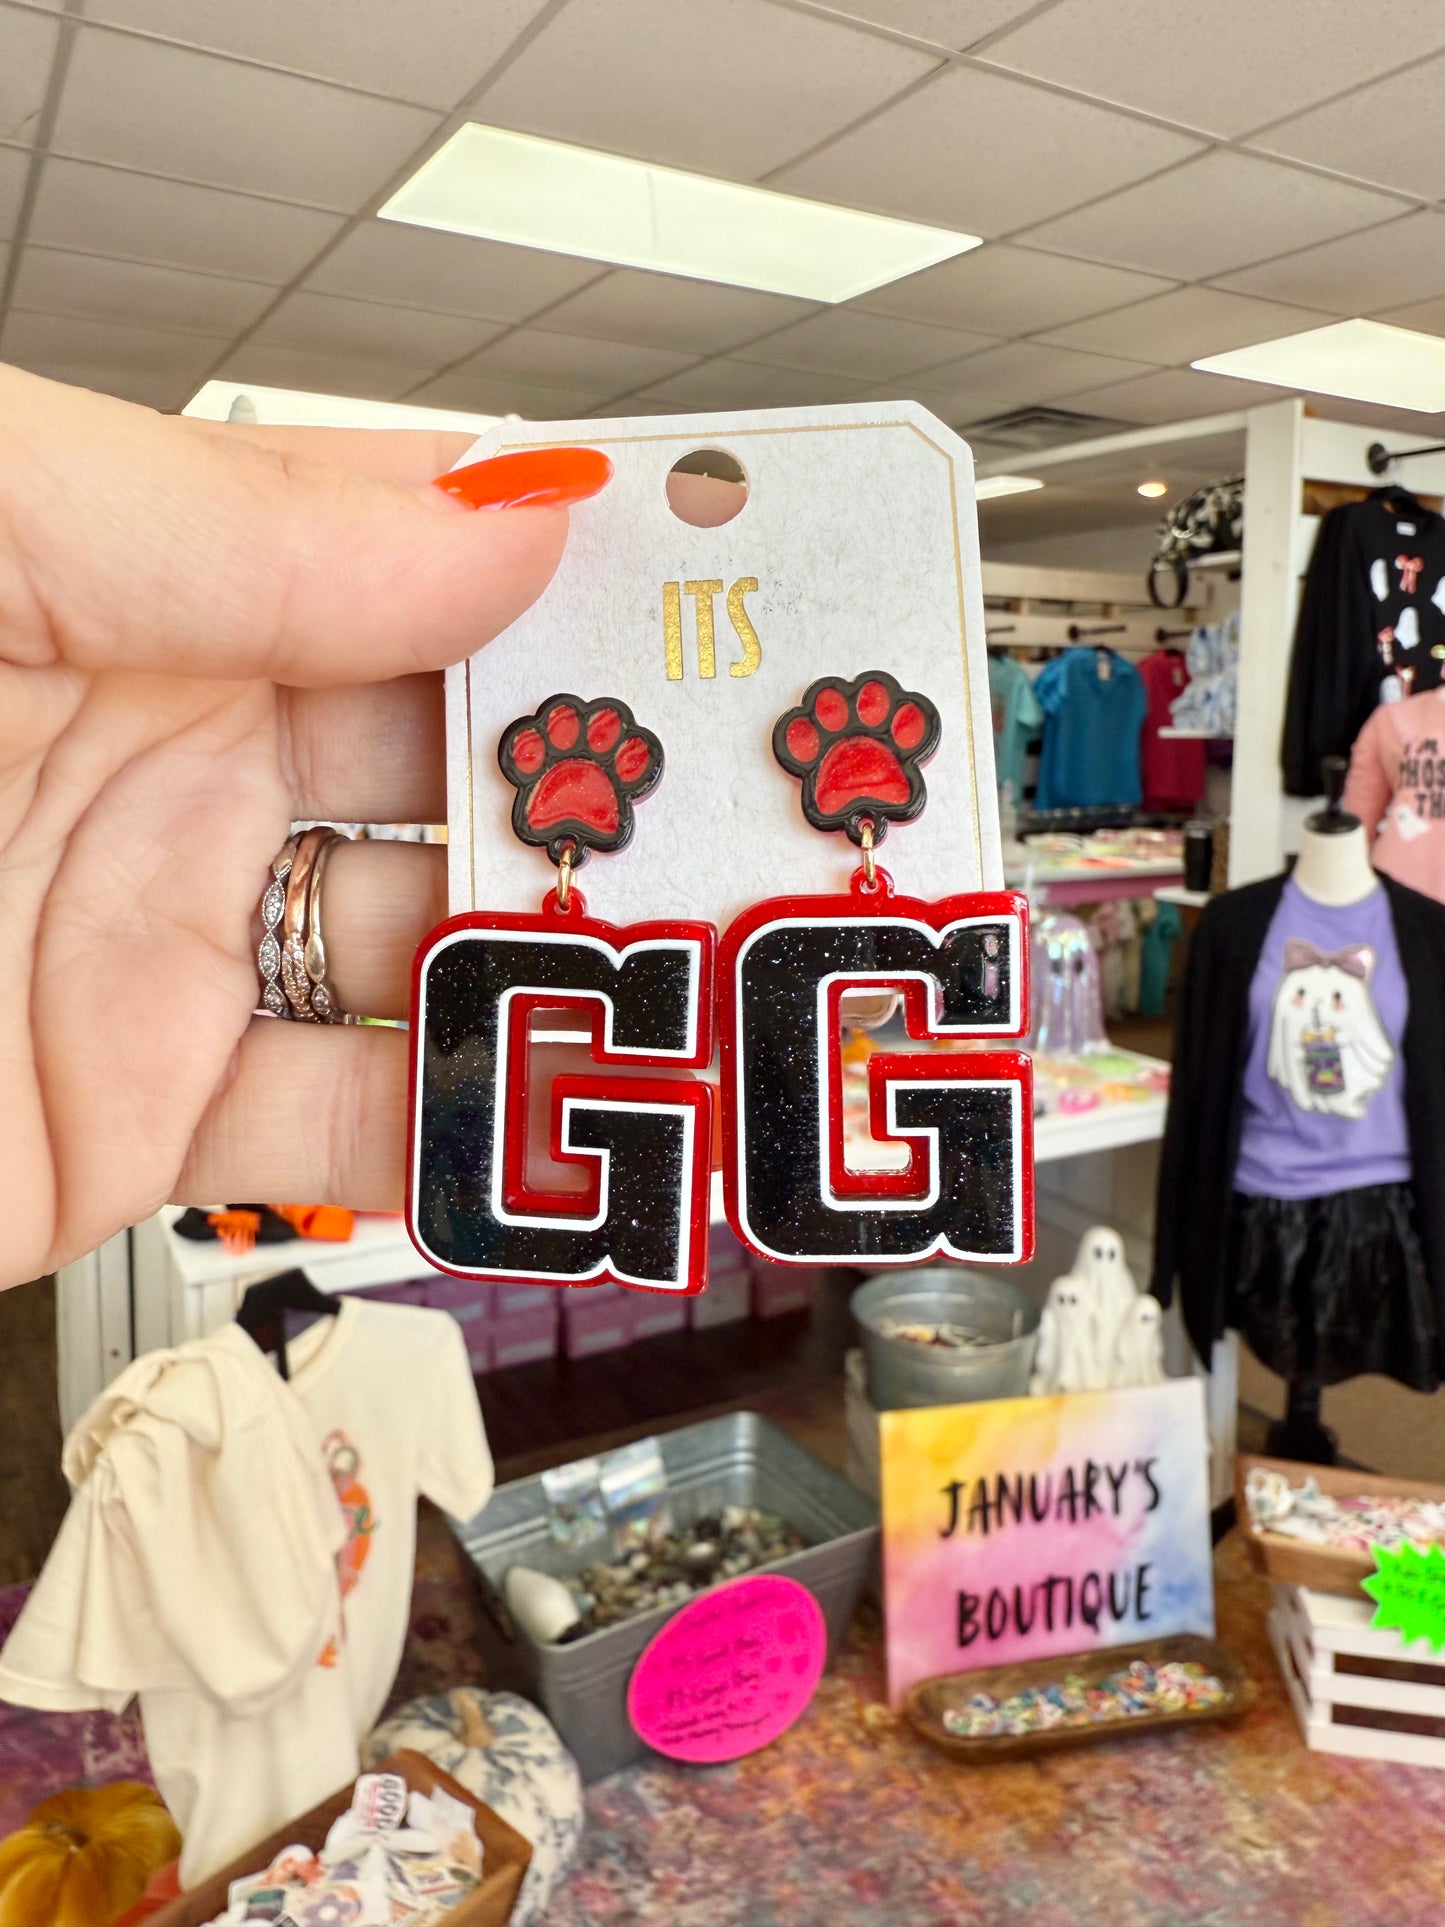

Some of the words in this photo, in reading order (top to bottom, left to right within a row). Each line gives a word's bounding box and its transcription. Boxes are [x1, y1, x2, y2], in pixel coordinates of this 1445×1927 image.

[662, 576, 762, 681] ITS
[405, 911, 717, 1296] G
[718, 891, 1036, 1265] G
[939, 1457, 1161, 1540] JANUARY'S
[956, 1564, 1154, 1648] BOUTIQUE
